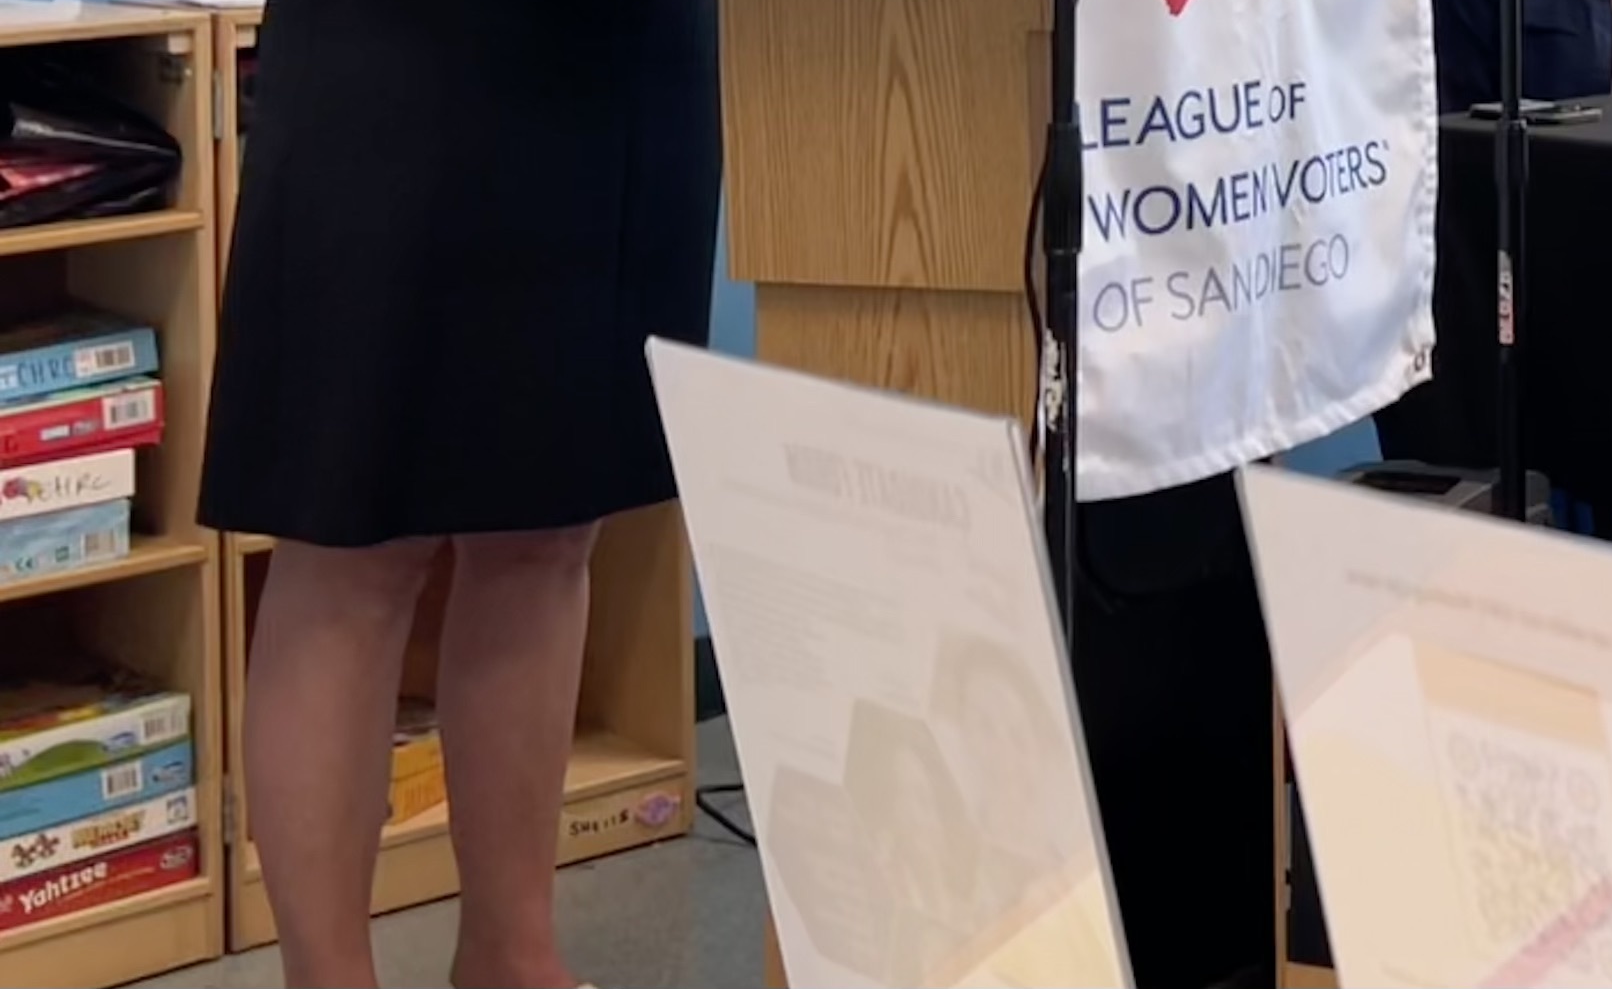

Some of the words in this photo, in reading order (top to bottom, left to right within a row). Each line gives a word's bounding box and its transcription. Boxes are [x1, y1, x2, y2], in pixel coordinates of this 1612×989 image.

[1269, 82, 1306, 123] OF
[1088, 165, 1267, 242] WOMEN
[1093, 277, 1153, 332] OF
[1167, 262, 1252, 320] SAN
[1254, 234, 1349, 300] DIEGO
[18, 861, 108, 914] Yahtzee
